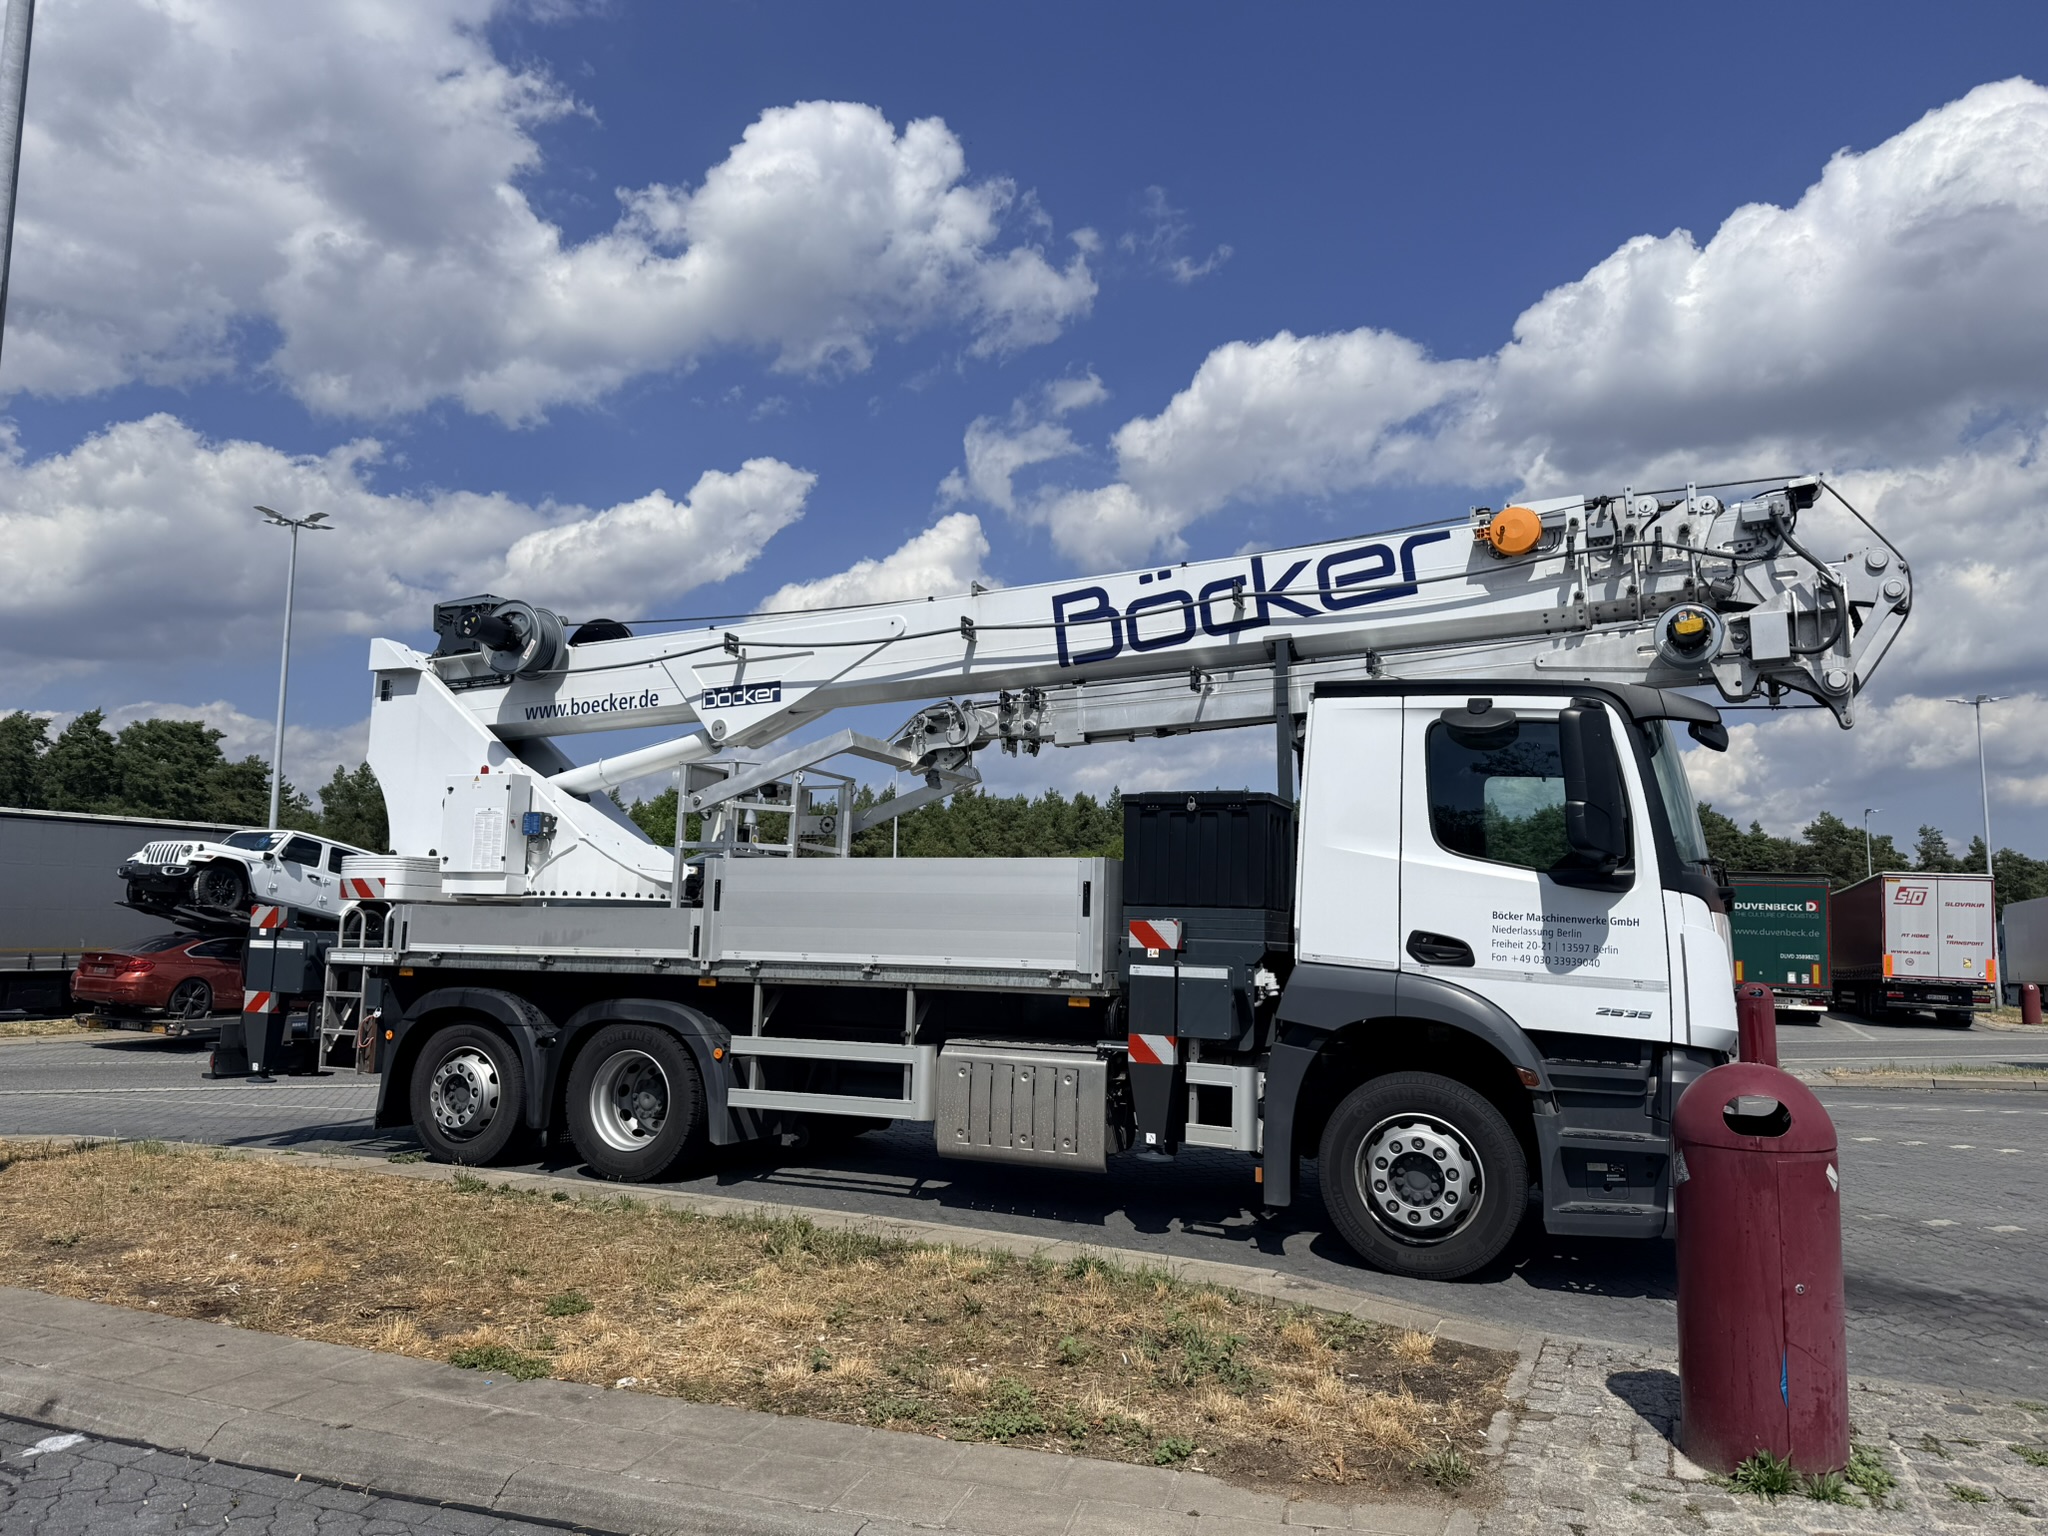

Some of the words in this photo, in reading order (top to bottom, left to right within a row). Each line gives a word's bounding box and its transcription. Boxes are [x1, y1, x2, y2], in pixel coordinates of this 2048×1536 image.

[1052, 530, 1450, 668] Böcker
[525, 689, 659, 720] www.boecker.de
[702, 687, 780, 709] Böcker
[1734, 902, 1803, 911] DUVENBECK
[1492, 911, 1523, 920] Böcker
[1526, 912, 1607, 925] Maschinenwerke
[1610, 916, 1640, 927] GmbH
[1492, 924, 1554, 939] Niederlassung
[1557, 927, 1582, 938] Berlin
[1734, 927, 1820, 938] www.duvenbeck.de
[1491, 938, 1524, 949] Freiheit
[1526, 941, 1551, 951] 20-21
[1562, 943, 1590, 953] 13597
[1593, 945, 1619, 955] Berlin
[1491, 952, 1508, 962] Fon
[1511, 954, 1531, 964] +49
[1533, 954, 1552, 965] 030
[1553, 955, 1601, 968] 33939040
[1595, 1007, 1653, 1020] 2535
